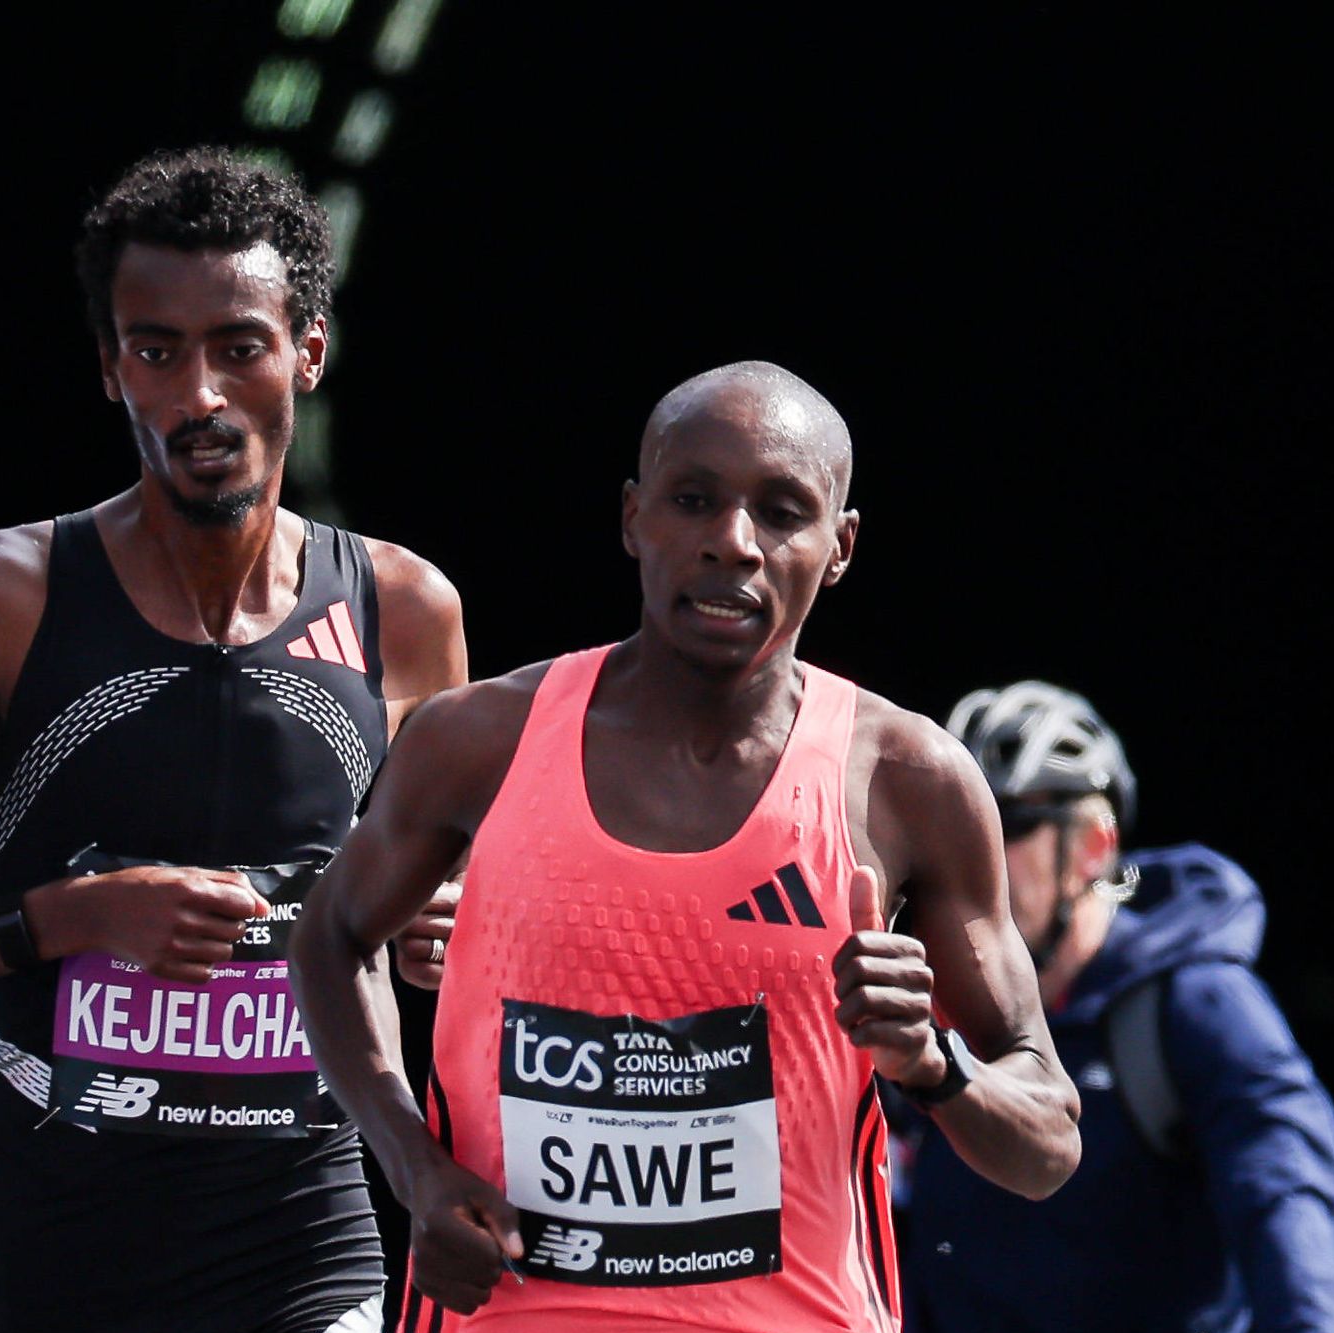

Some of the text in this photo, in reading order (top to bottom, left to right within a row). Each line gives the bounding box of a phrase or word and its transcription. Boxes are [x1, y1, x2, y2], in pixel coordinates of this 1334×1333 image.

[68, 979, 312, 1060] KEJELCHA
[613, 1032, 673, 1050] TATA
[515, 1019, 605, 1092] tcs
[614, 1044, 752, 1073] CONSULTANCY
[613, 1077, 707, 1096] SERVICES
[158, 1105, 296, 1127] new balance
[540, 1135, 737, 1208] SAWE
[605, 1247, 755, 1275] new balance
